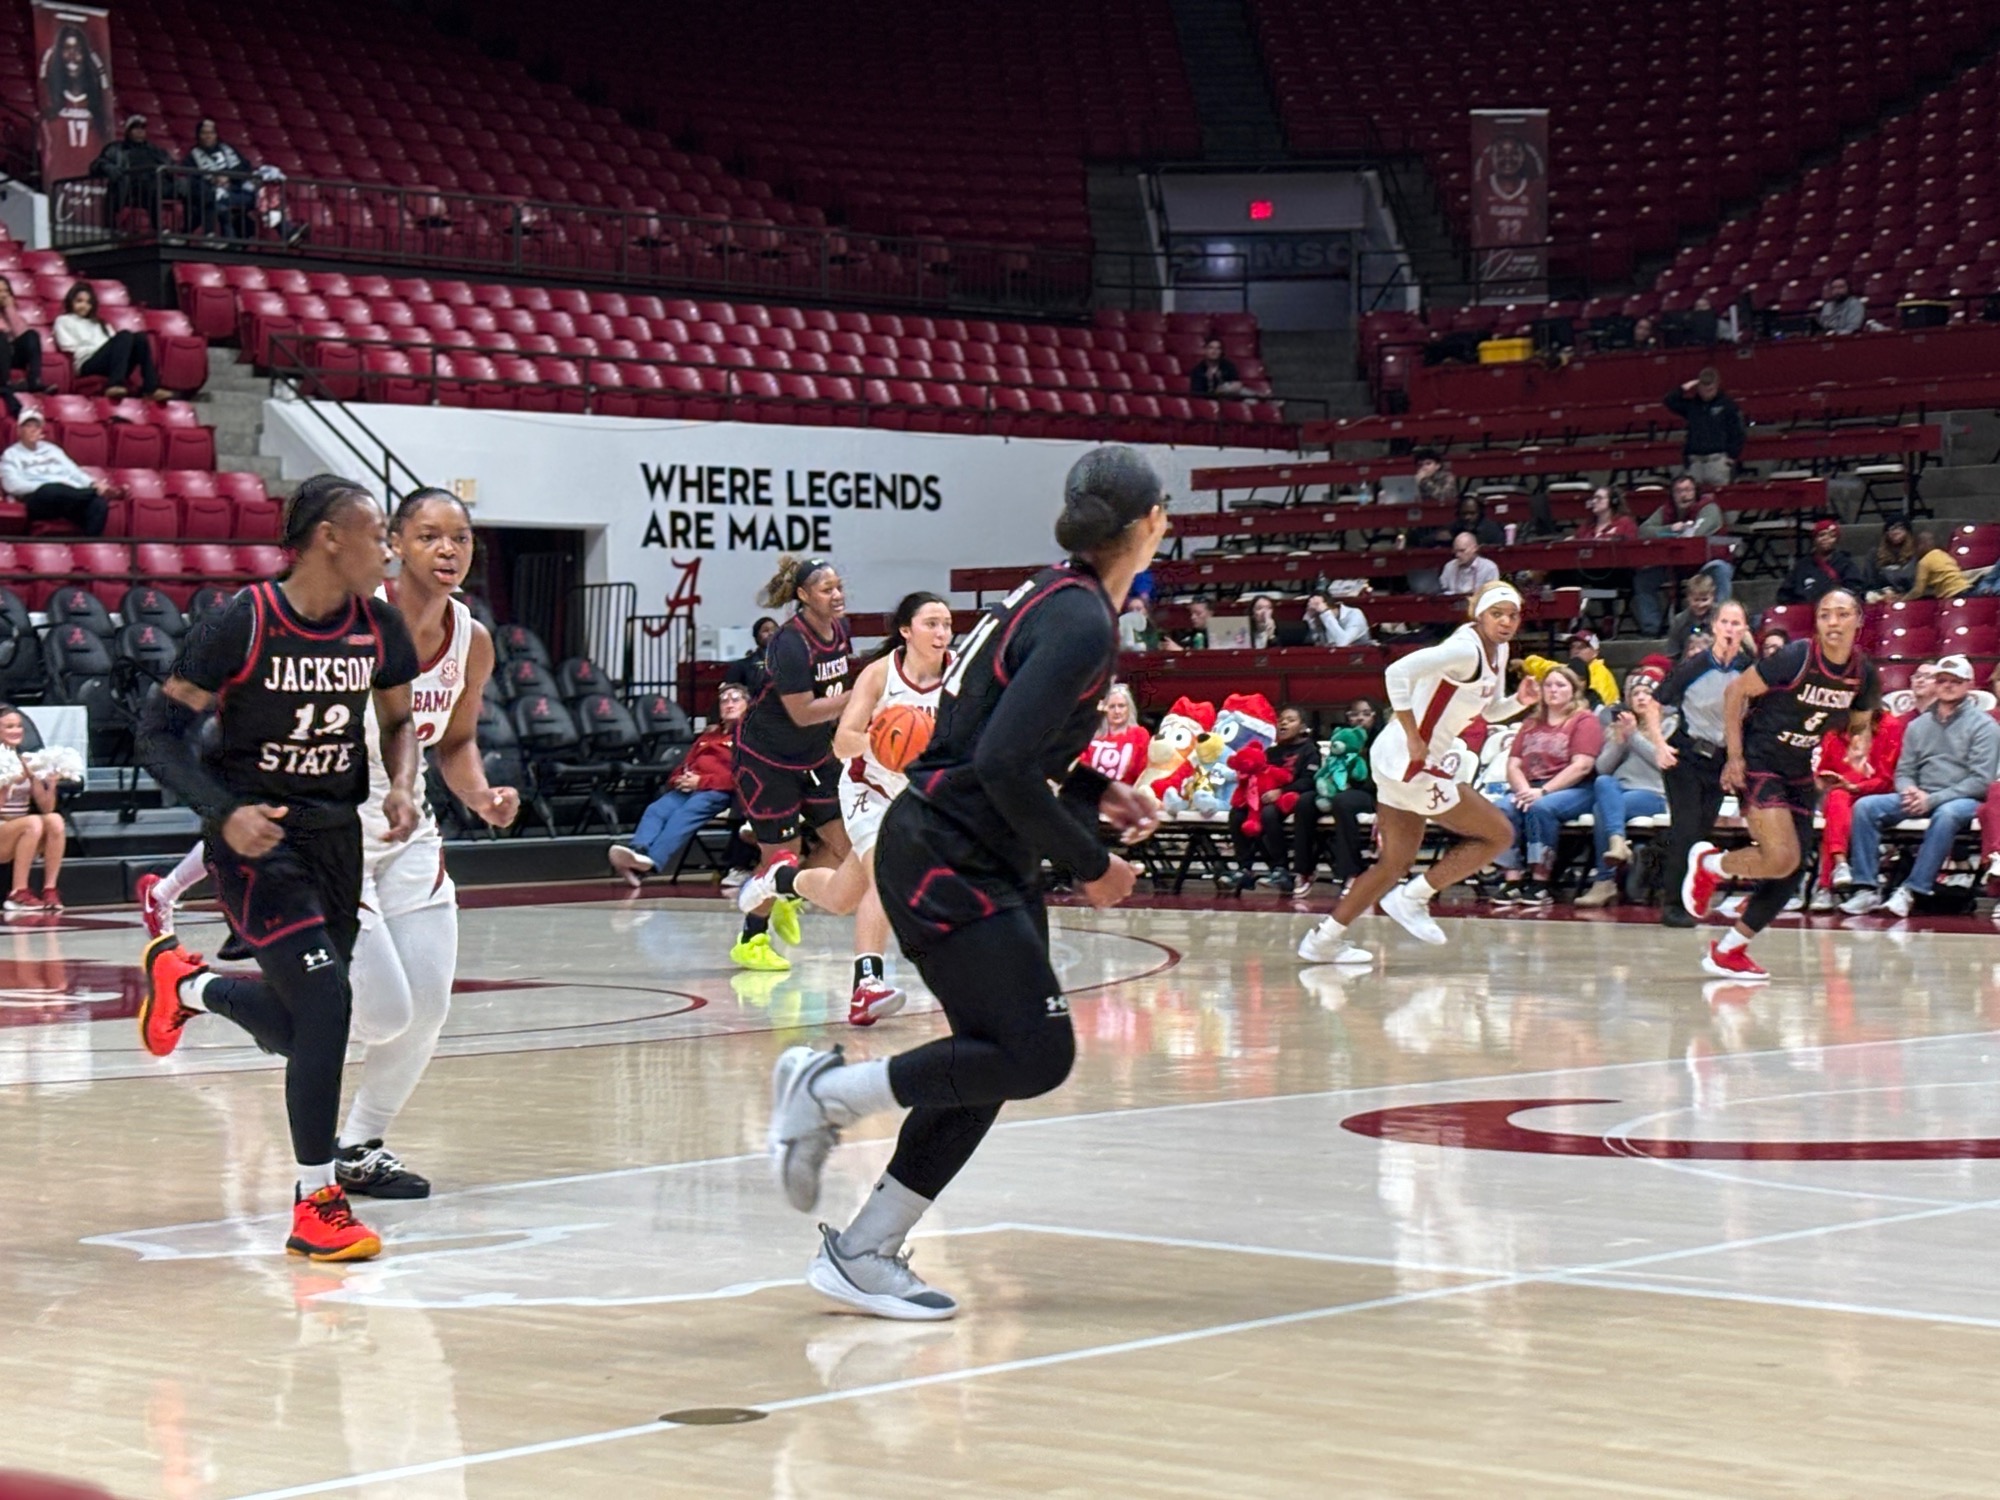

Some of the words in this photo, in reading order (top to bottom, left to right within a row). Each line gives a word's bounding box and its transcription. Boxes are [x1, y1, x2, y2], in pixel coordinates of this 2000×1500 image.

[67, 120, 89, 147] 17
[640, 463, 773, 506] WHERE
[786, 470, 943, 512] LEGENDS
[641, 510, 715, 550] ARE
[729, 513, 832, 552] MADE
[642, 556, 702, 638] A
[263, 656, 377, 693] JACKSON
[412, 689, 453, 712] BAMA
[1797, 683, 1857, 709] JACKSON
[289, 702, 351, 741] 12
[258, 741, 355, 777] STATE
[847, 789, 870, 820] A
